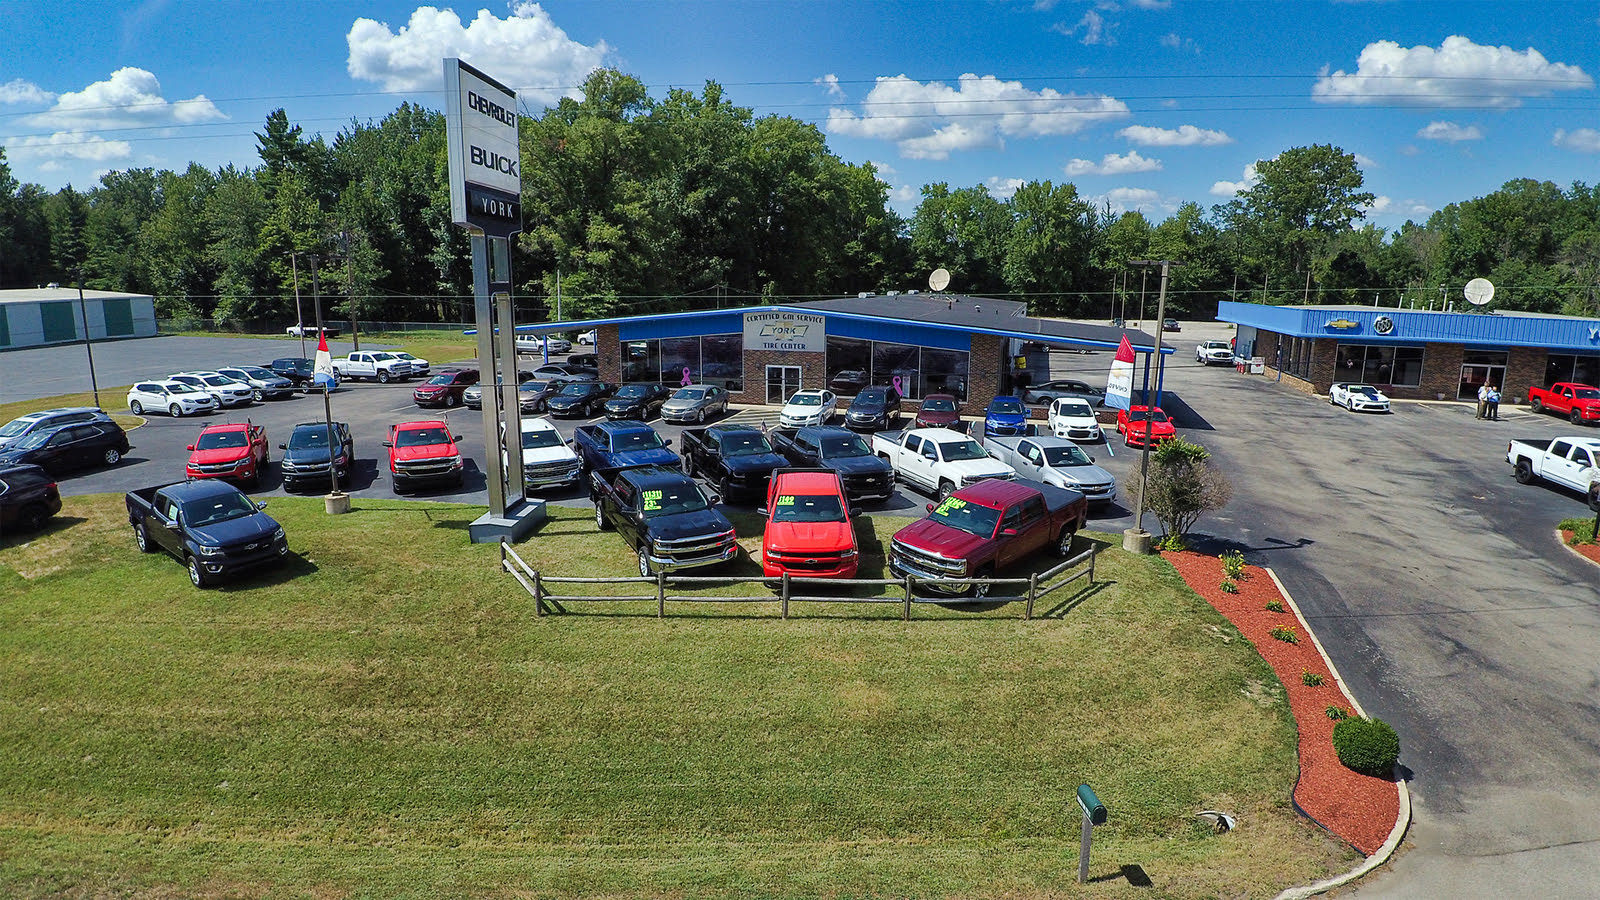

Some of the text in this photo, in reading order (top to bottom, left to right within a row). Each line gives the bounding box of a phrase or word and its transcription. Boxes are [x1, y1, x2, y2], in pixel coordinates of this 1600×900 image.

[468, 90, 516, 129] CHEVROLET
[470, 144, 518, 178] BUICK
[481, 197, 514, 219] YORK
[746, 313, 780, 323] CERTIFIED
[796, 313, 823, 324] SERVICE
[771, 327, 797, 335] YORK
[1588, 327, 1600, 339] Y
[763, 342, 806, 350] TIRE CENTER
